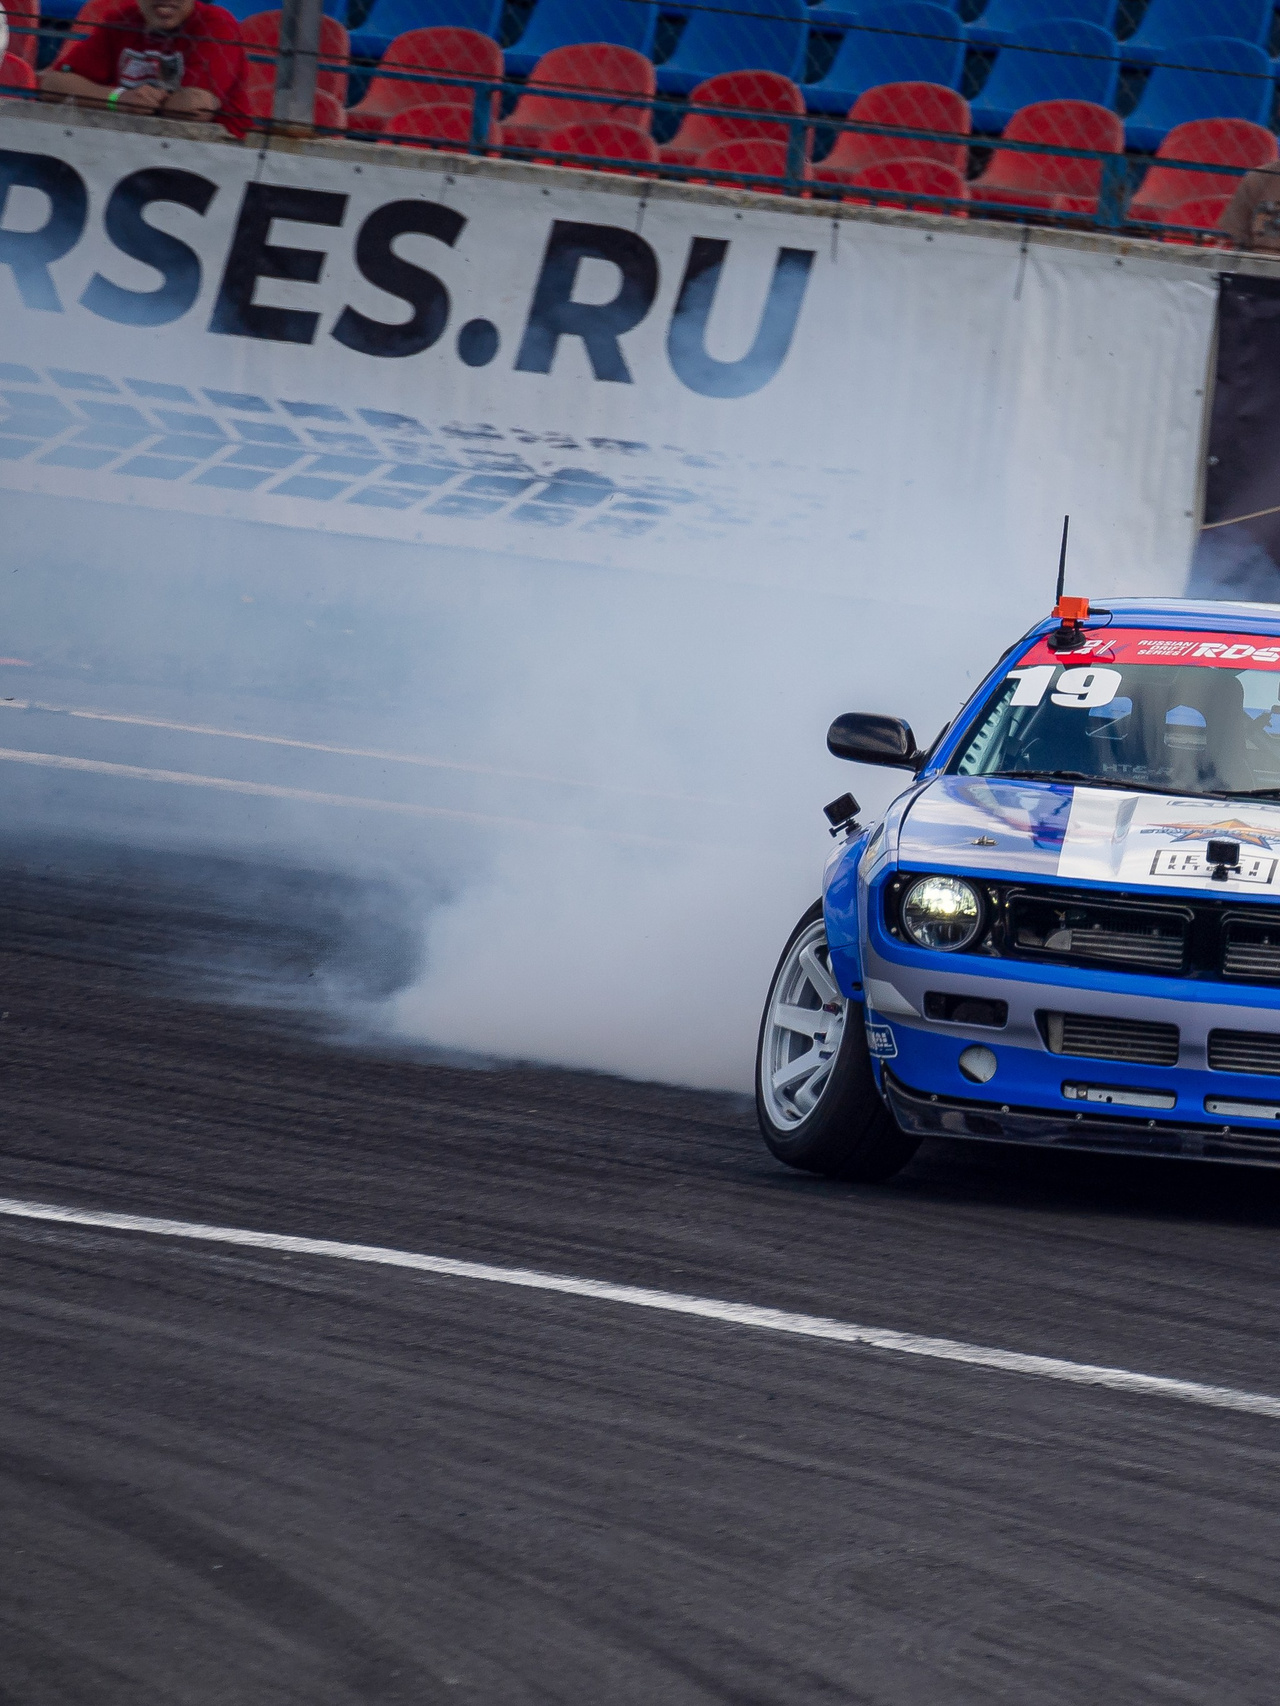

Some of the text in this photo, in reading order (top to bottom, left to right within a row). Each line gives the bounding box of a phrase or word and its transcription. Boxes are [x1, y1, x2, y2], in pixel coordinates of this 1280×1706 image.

[0, 149, 817, 399] RSES.RU
[1136, 649, 1182, 657] SERIES
[1137, 639, 1194, 648] RUSSIAN
[1006, 665, 1123, 708] 19
